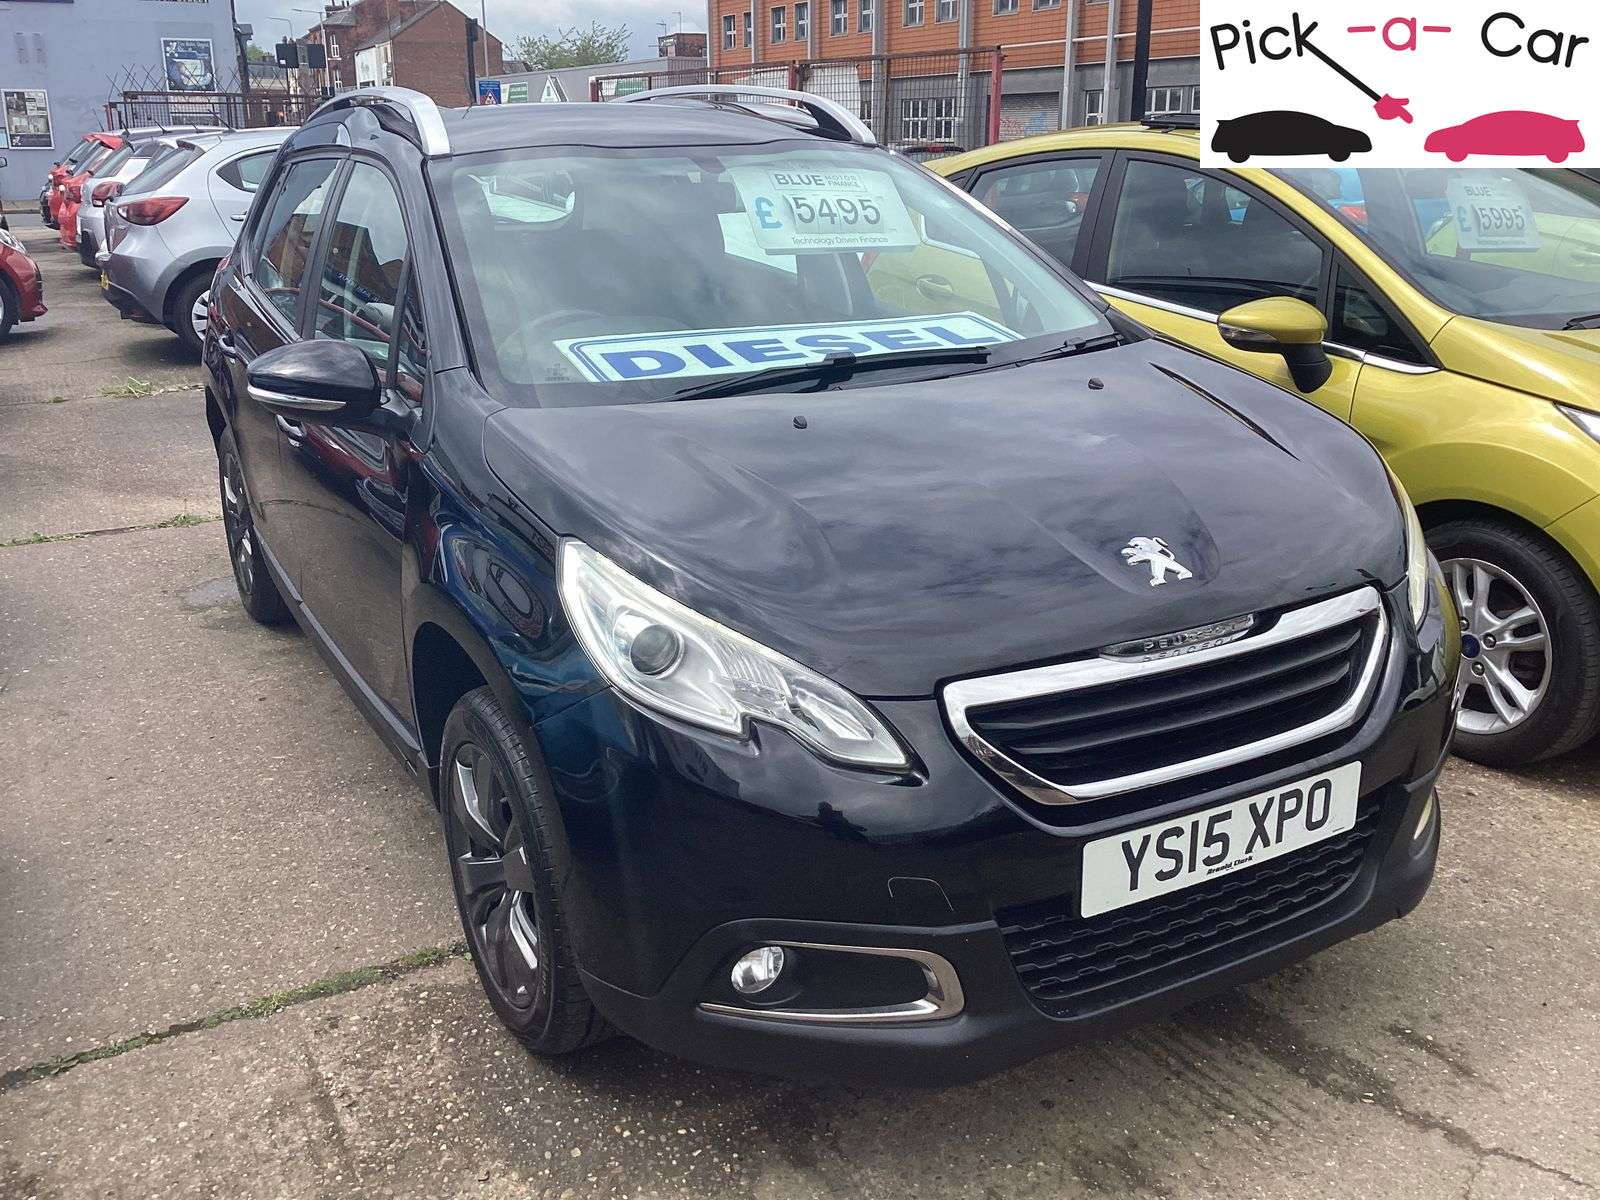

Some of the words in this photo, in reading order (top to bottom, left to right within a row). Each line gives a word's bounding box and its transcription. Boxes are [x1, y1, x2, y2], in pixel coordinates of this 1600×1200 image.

[774, 173, 825, 186] BLUE
[1463, 185, 1492, 197] BLUE
[791, 196, 881, 225] 5495
[1477, 206, 1525, 230] 5995
[792, 237, 834, 246] Technology
[600, 326, 996, 380] DIESEL
[1121, 809, 1233, 892] YS15
[1244, 778, 1333, 854] XPO
